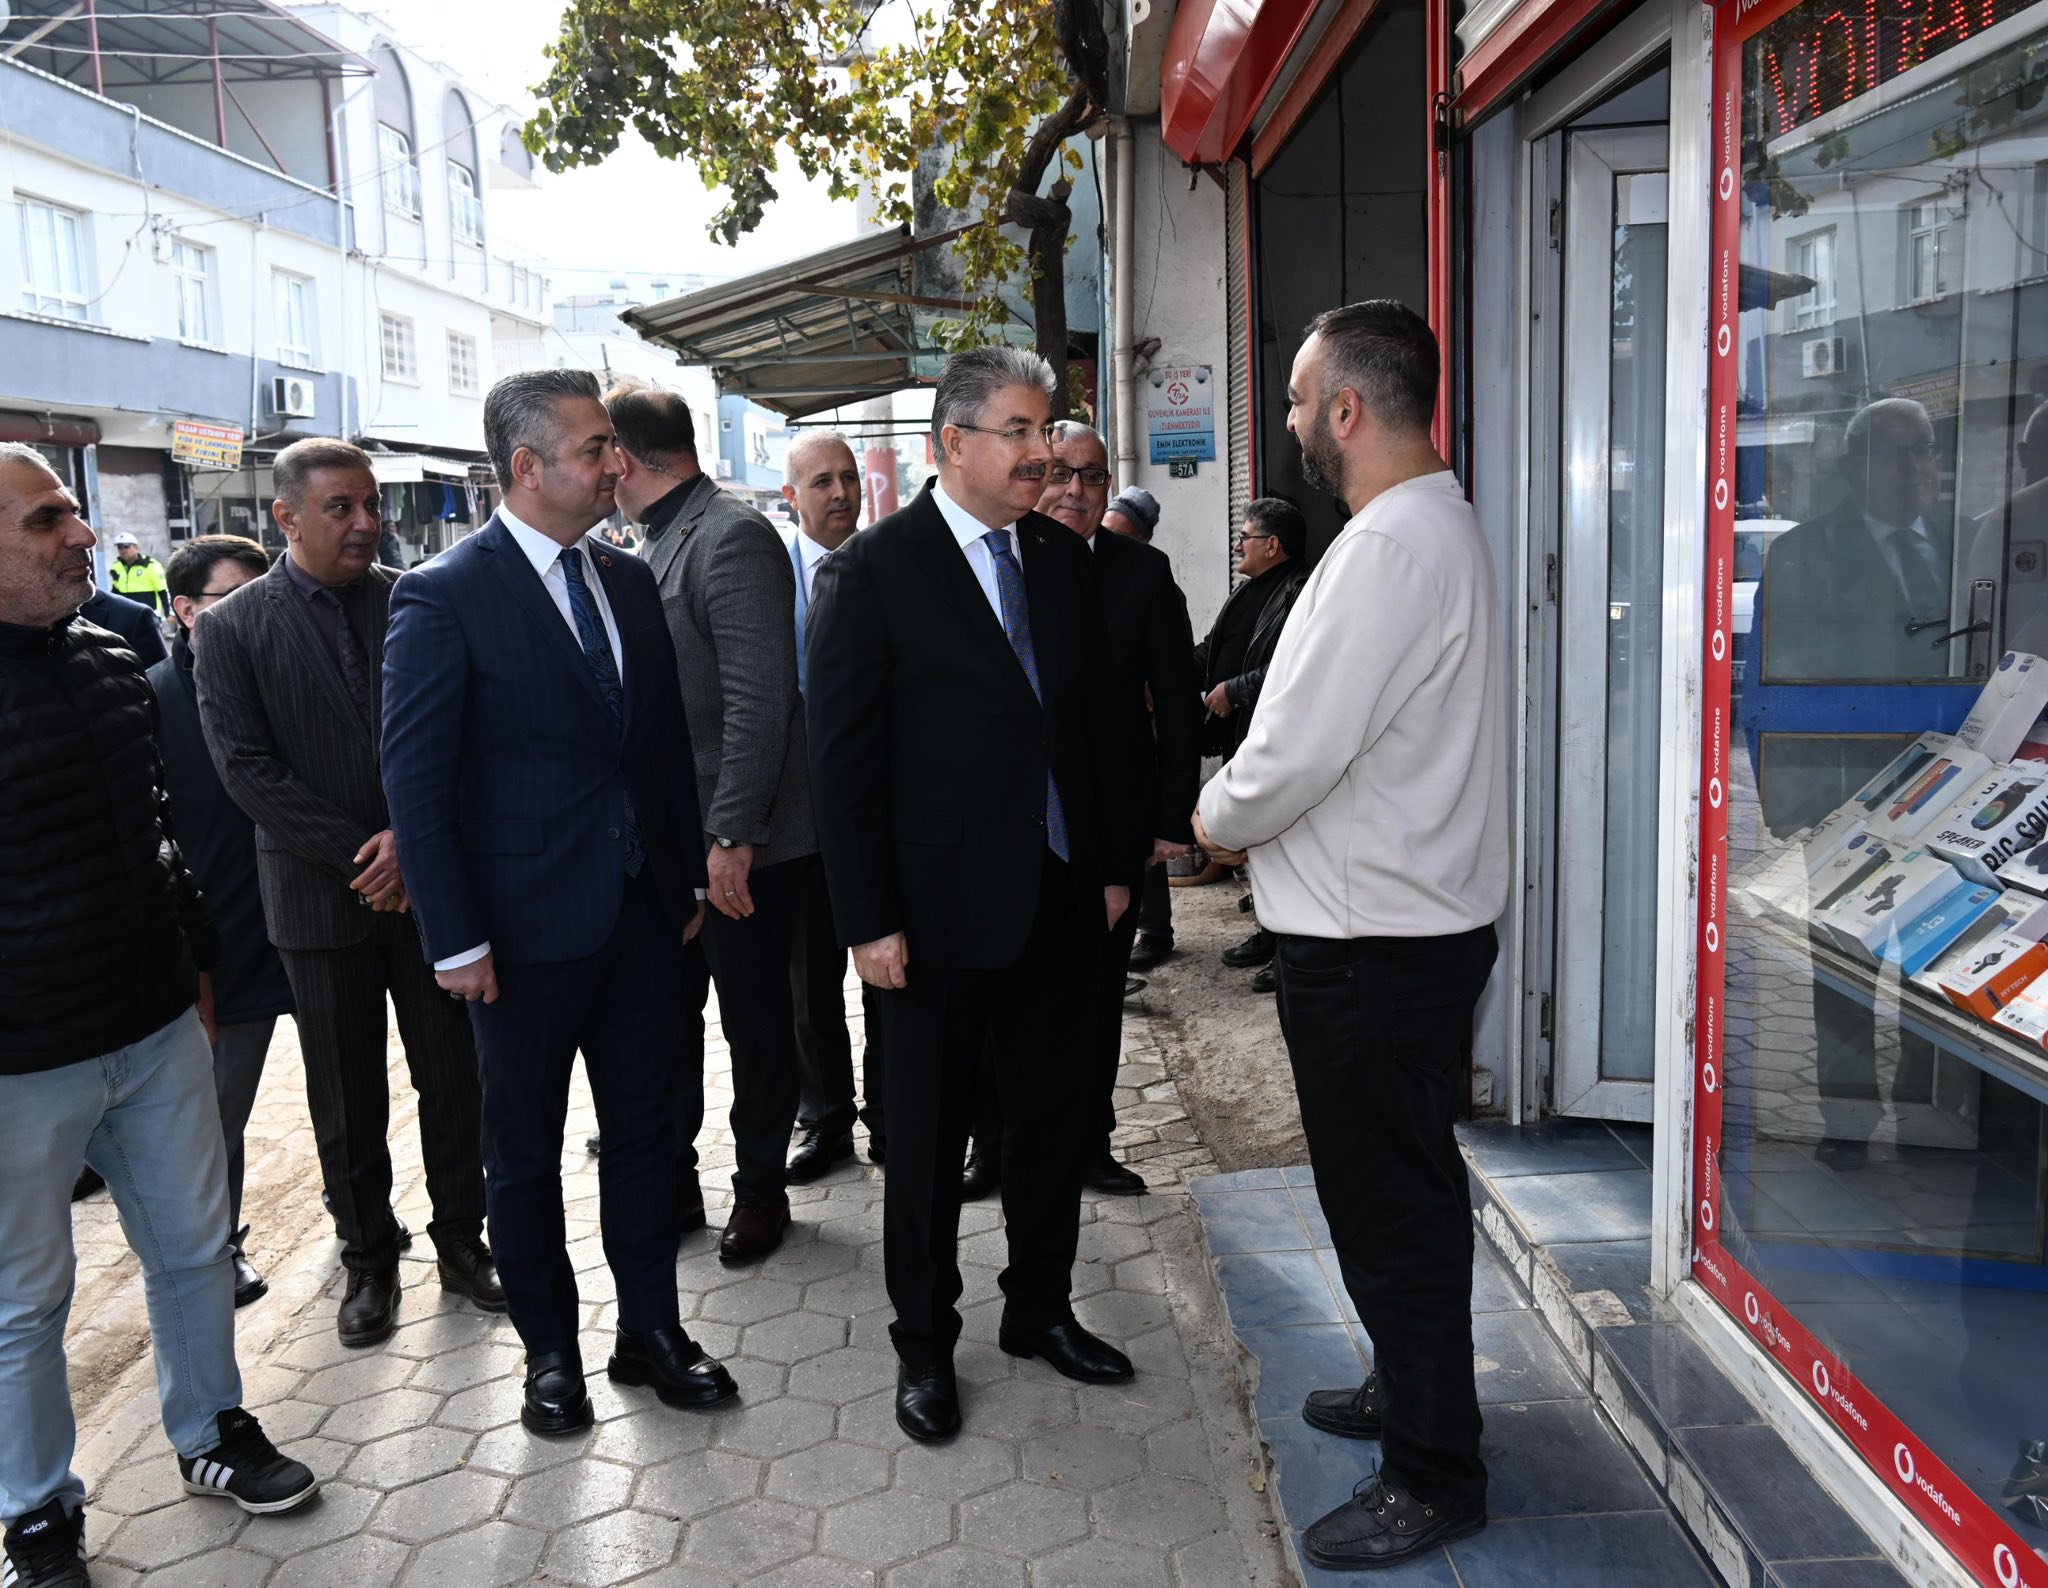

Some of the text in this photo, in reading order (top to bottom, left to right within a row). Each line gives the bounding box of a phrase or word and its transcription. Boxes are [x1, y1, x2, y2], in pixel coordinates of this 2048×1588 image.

[1724, 91, 1732, 164] vodafone
[1178, 464, 1194, 476] 57A
[1936, 830, 1986, 850] SPEAKER
[1710, 853, 1718, 919] vodafone
[1700, 1253, 1727, 1287] vodafone
[1830, 1385, 1868, 1431] vodafone
[1915, 1472, 1961, 1527] vodafone
